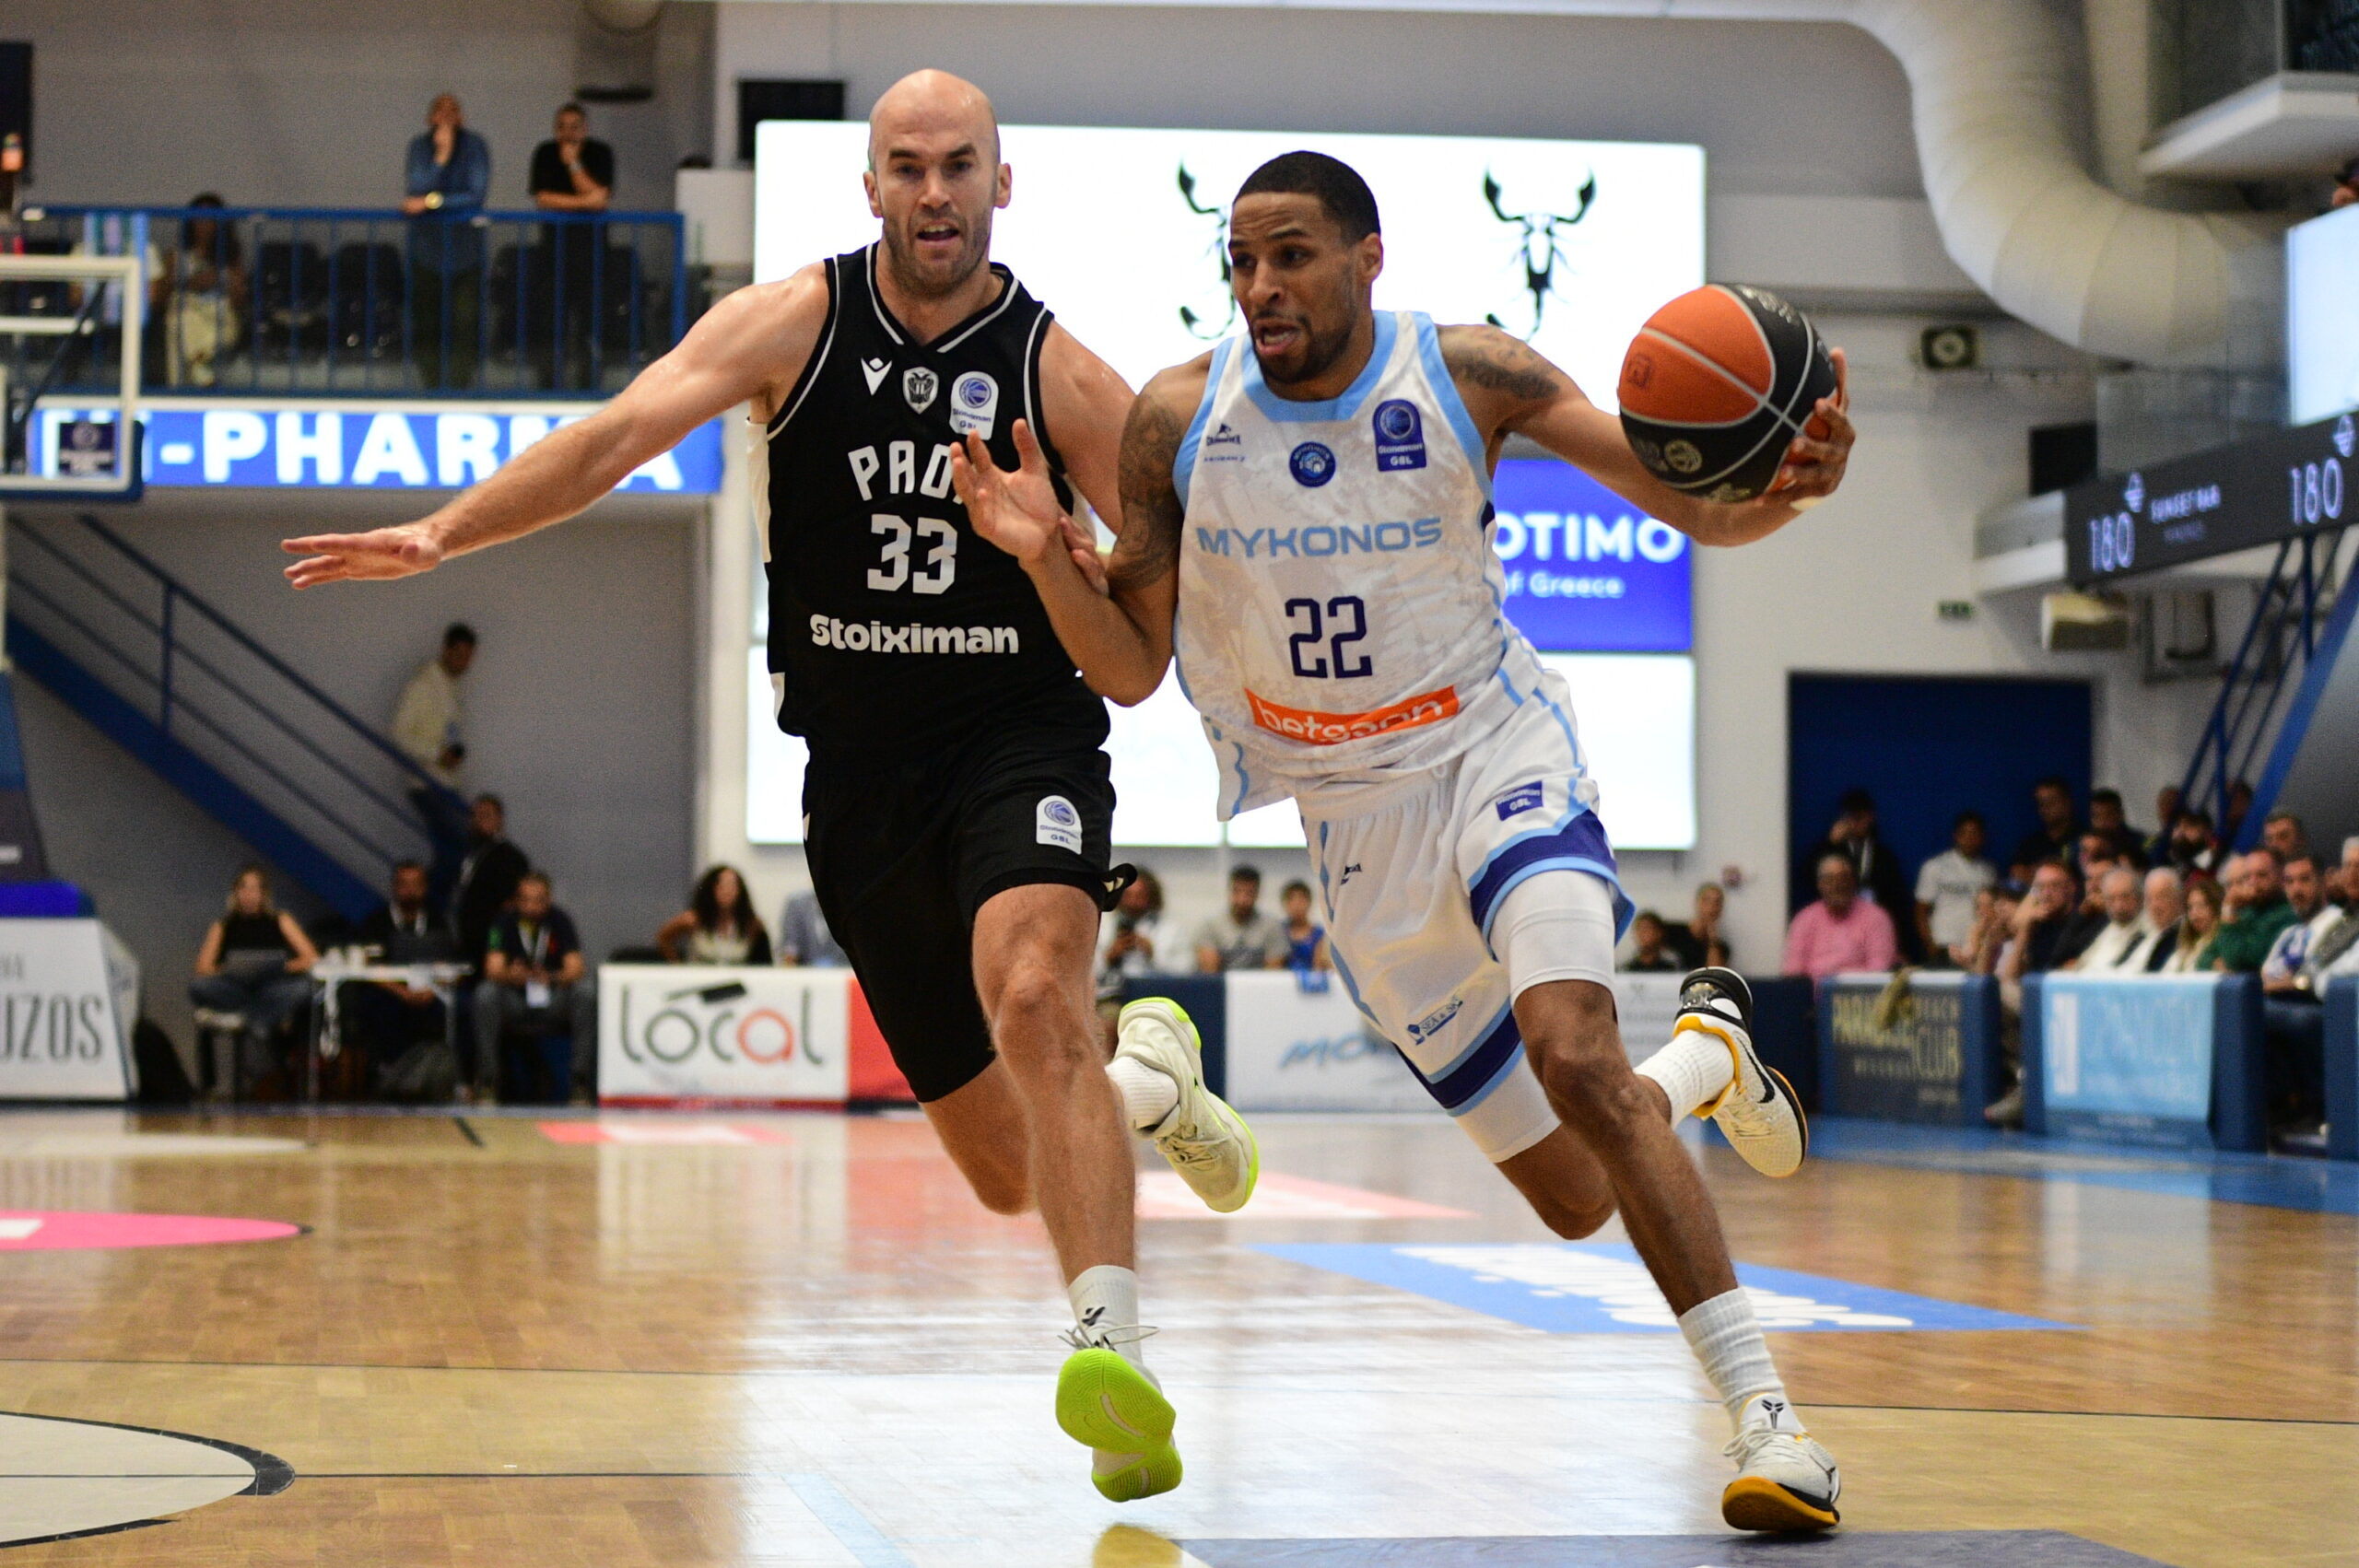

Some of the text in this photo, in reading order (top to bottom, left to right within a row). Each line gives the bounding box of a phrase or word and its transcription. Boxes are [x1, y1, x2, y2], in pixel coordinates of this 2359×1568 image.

[848, 440, 964, 505] PAO
[2291, 458, 2344, 524] 180
[867, 513, 958, 595] 33
[1196, 517, 1443, 559] MYKONOS
[2090, 512, 2135, 572] 180
[1530, 570, 1625, 599] Greece
[1285, 595, 1373, 679] 22
